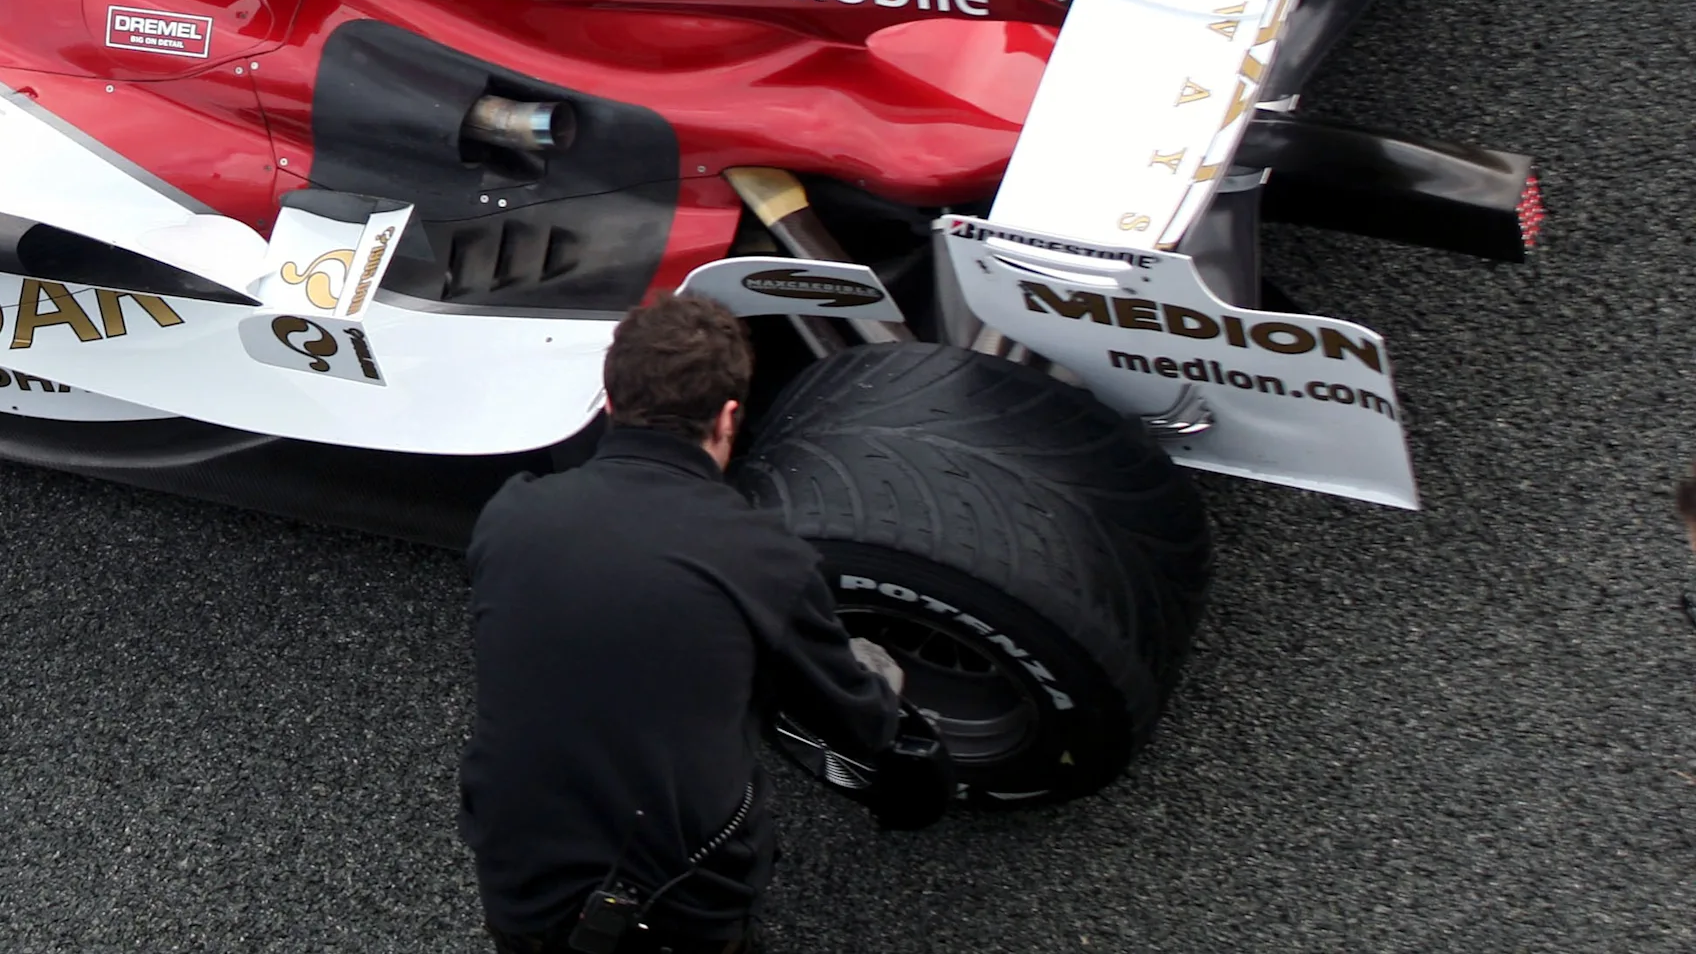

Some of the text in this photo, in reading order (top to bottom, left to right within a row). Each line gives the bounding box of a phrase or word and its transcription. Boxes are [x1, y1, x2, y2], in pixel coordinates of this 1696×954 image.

[114, 15, 202, 40] DREMEL
[130, 35, 185, 49] BIG ON DETAIL
[745, 276, 885, 300] MAXCREDIBLE
[1021, 279, 1383, 375] MEDION
[1109, 345, 1397, 421] medion.com
[840, 573, 1075, 711] POTENZA
